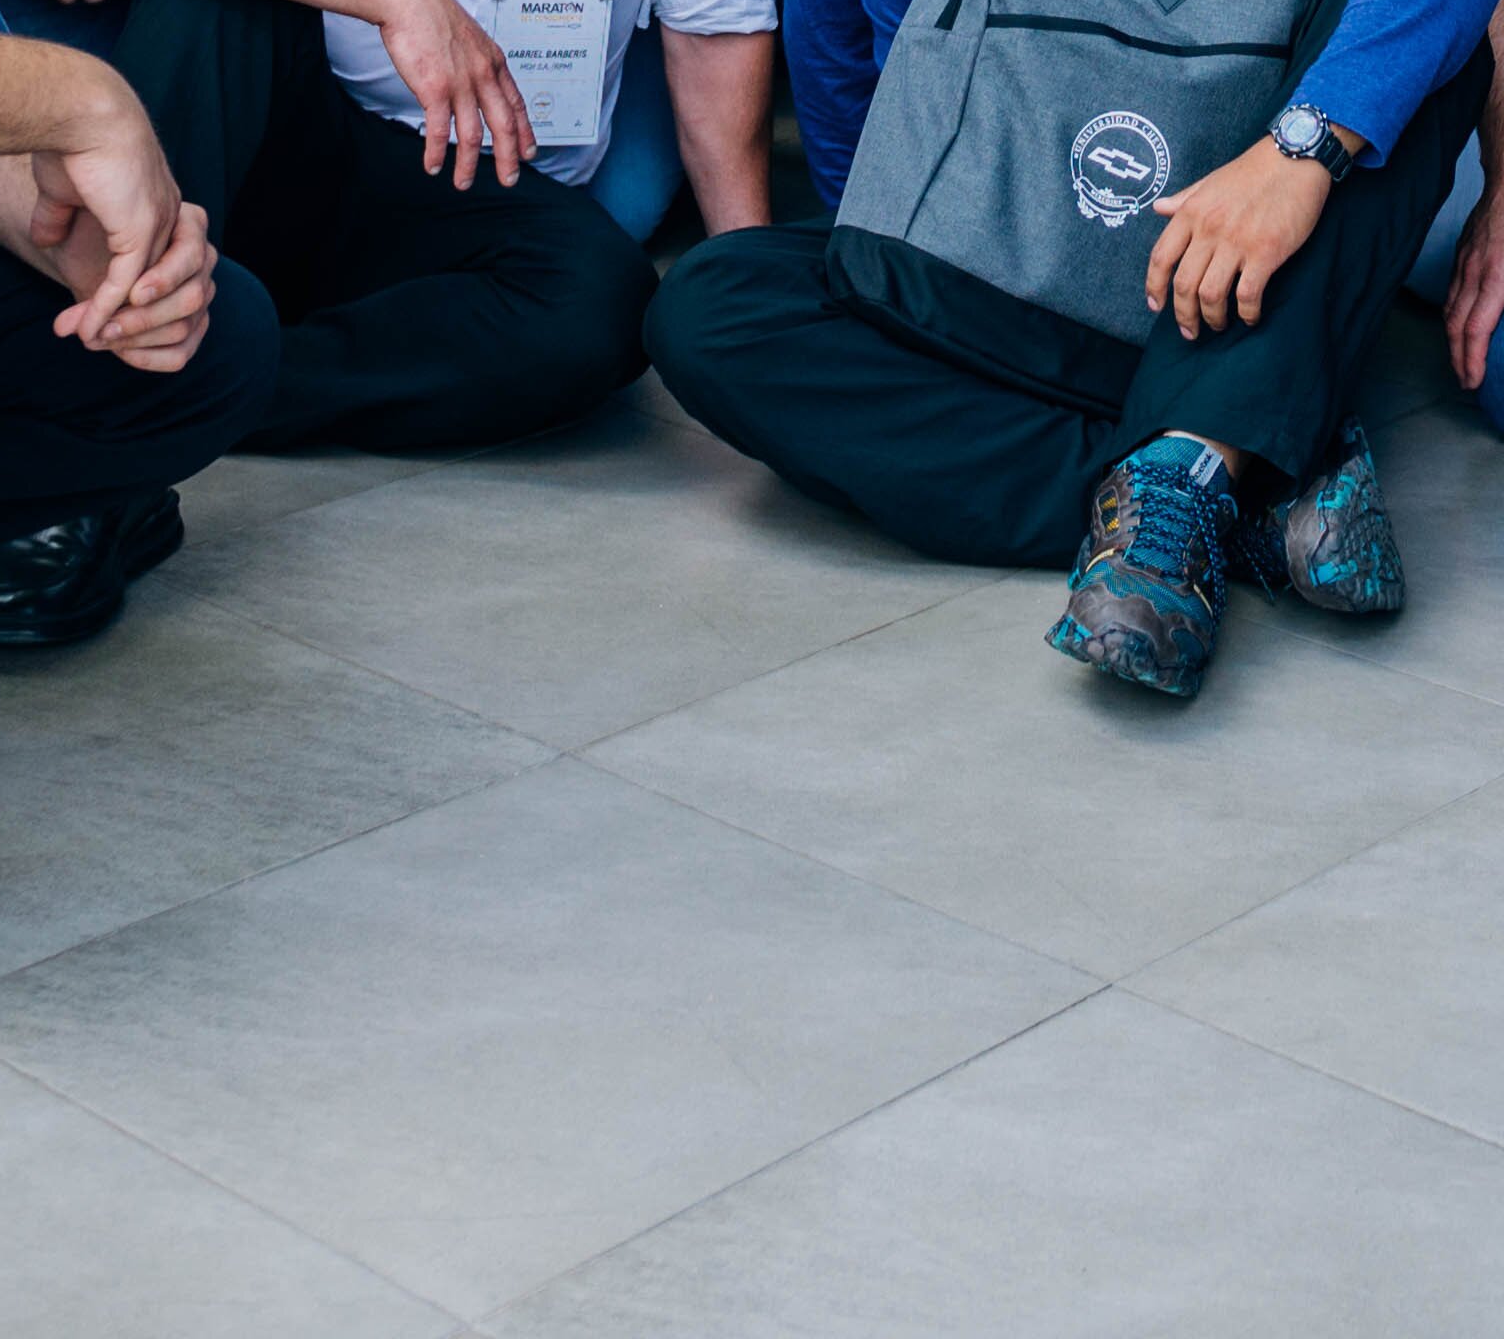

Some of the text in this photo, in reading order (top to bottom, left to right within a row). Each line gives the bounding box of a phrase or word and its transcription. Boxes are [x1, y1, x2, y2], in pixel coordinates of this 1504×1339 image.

[507, 49, 544, 59] GABRIEL
[1075, 115, 1167, 189] UNIVERSIDAD CHEVROLET
